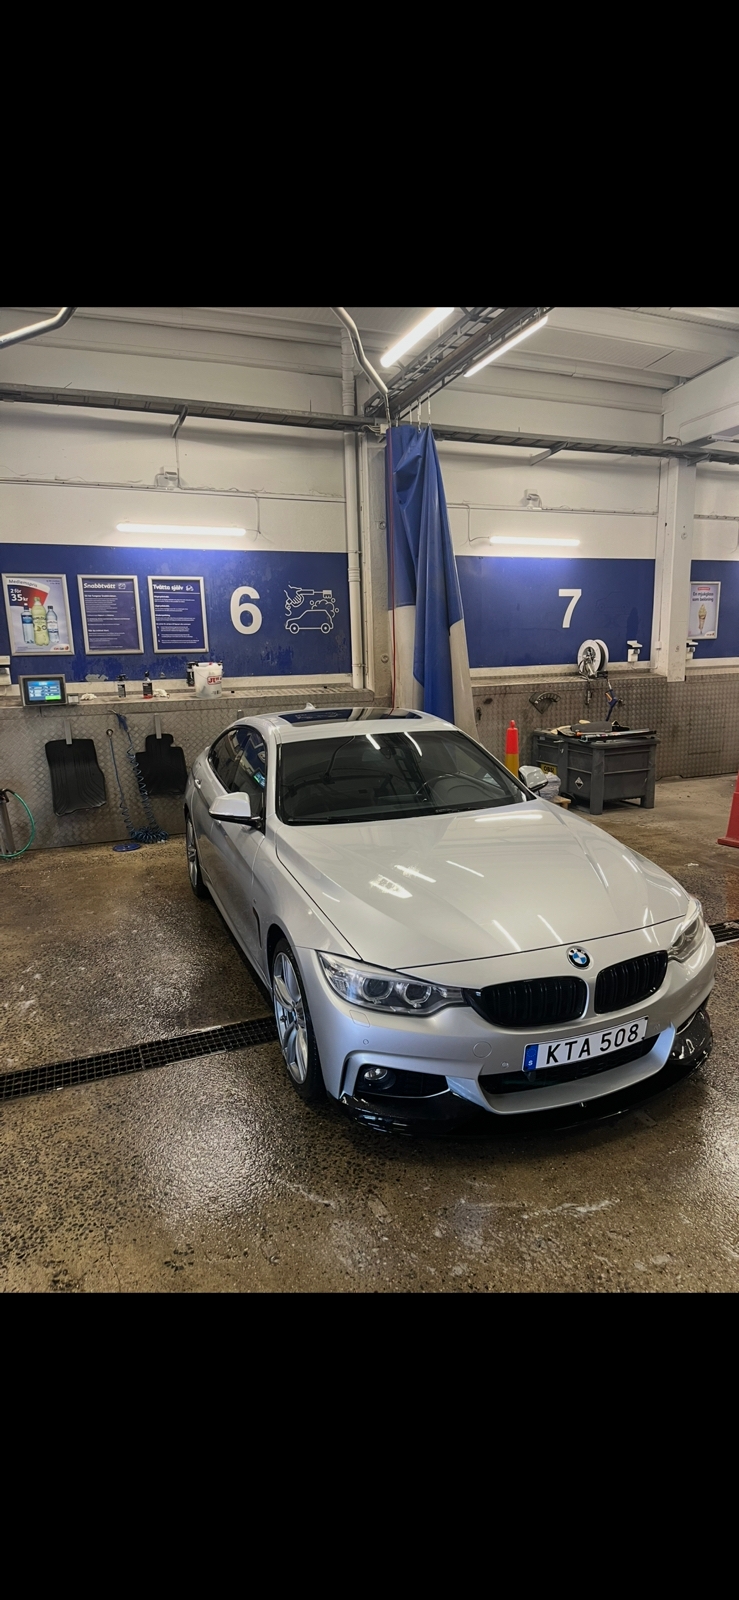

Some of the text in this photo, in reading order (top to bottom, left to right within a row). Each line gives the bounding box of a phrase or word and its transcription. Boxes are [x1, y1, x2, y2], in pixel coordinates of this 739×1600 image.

[11, 594, 23, 602] 35
[171, 584, 184, 592] själv
[558, 588, 582, 629] 7
[230, 586, 262, 635] 6
[546, 1023, 639, 1065] KTA 508
